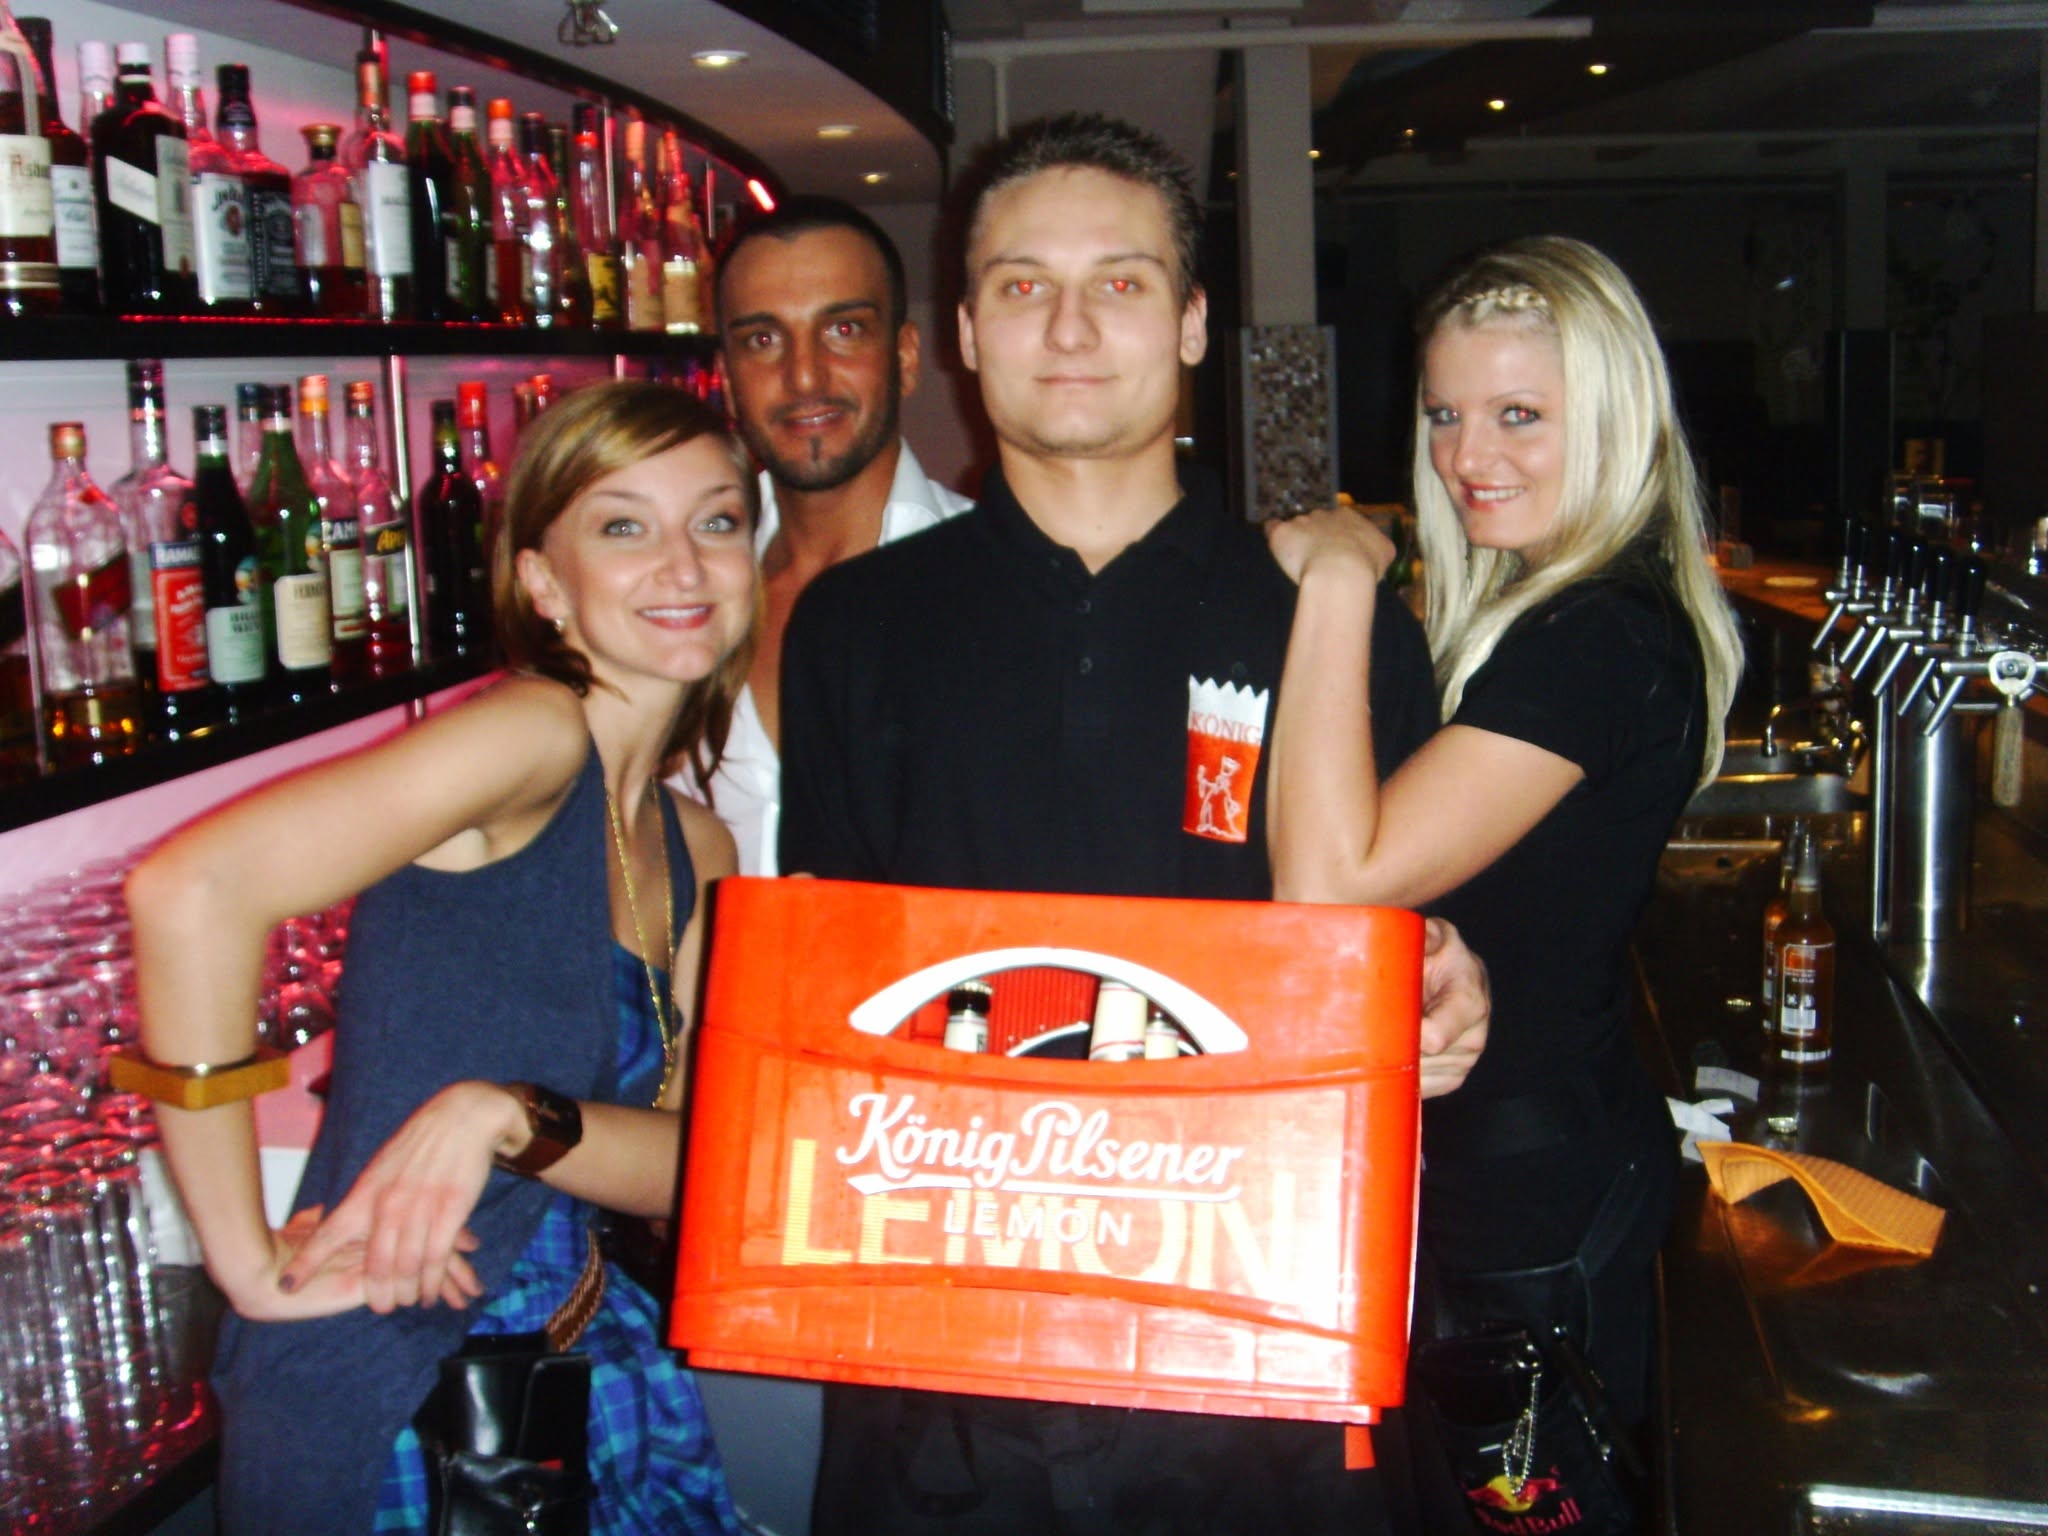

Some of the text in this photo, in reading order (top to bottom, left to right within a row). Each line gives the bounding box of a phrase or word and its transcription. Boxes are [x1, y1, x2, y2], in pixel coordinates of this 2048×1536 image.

[836, 1093, 1244, 1187] König Pilsener
[781, 1137, 1297, 1307] LEMON
[943, 1198, 1133, 1248] LEMON
